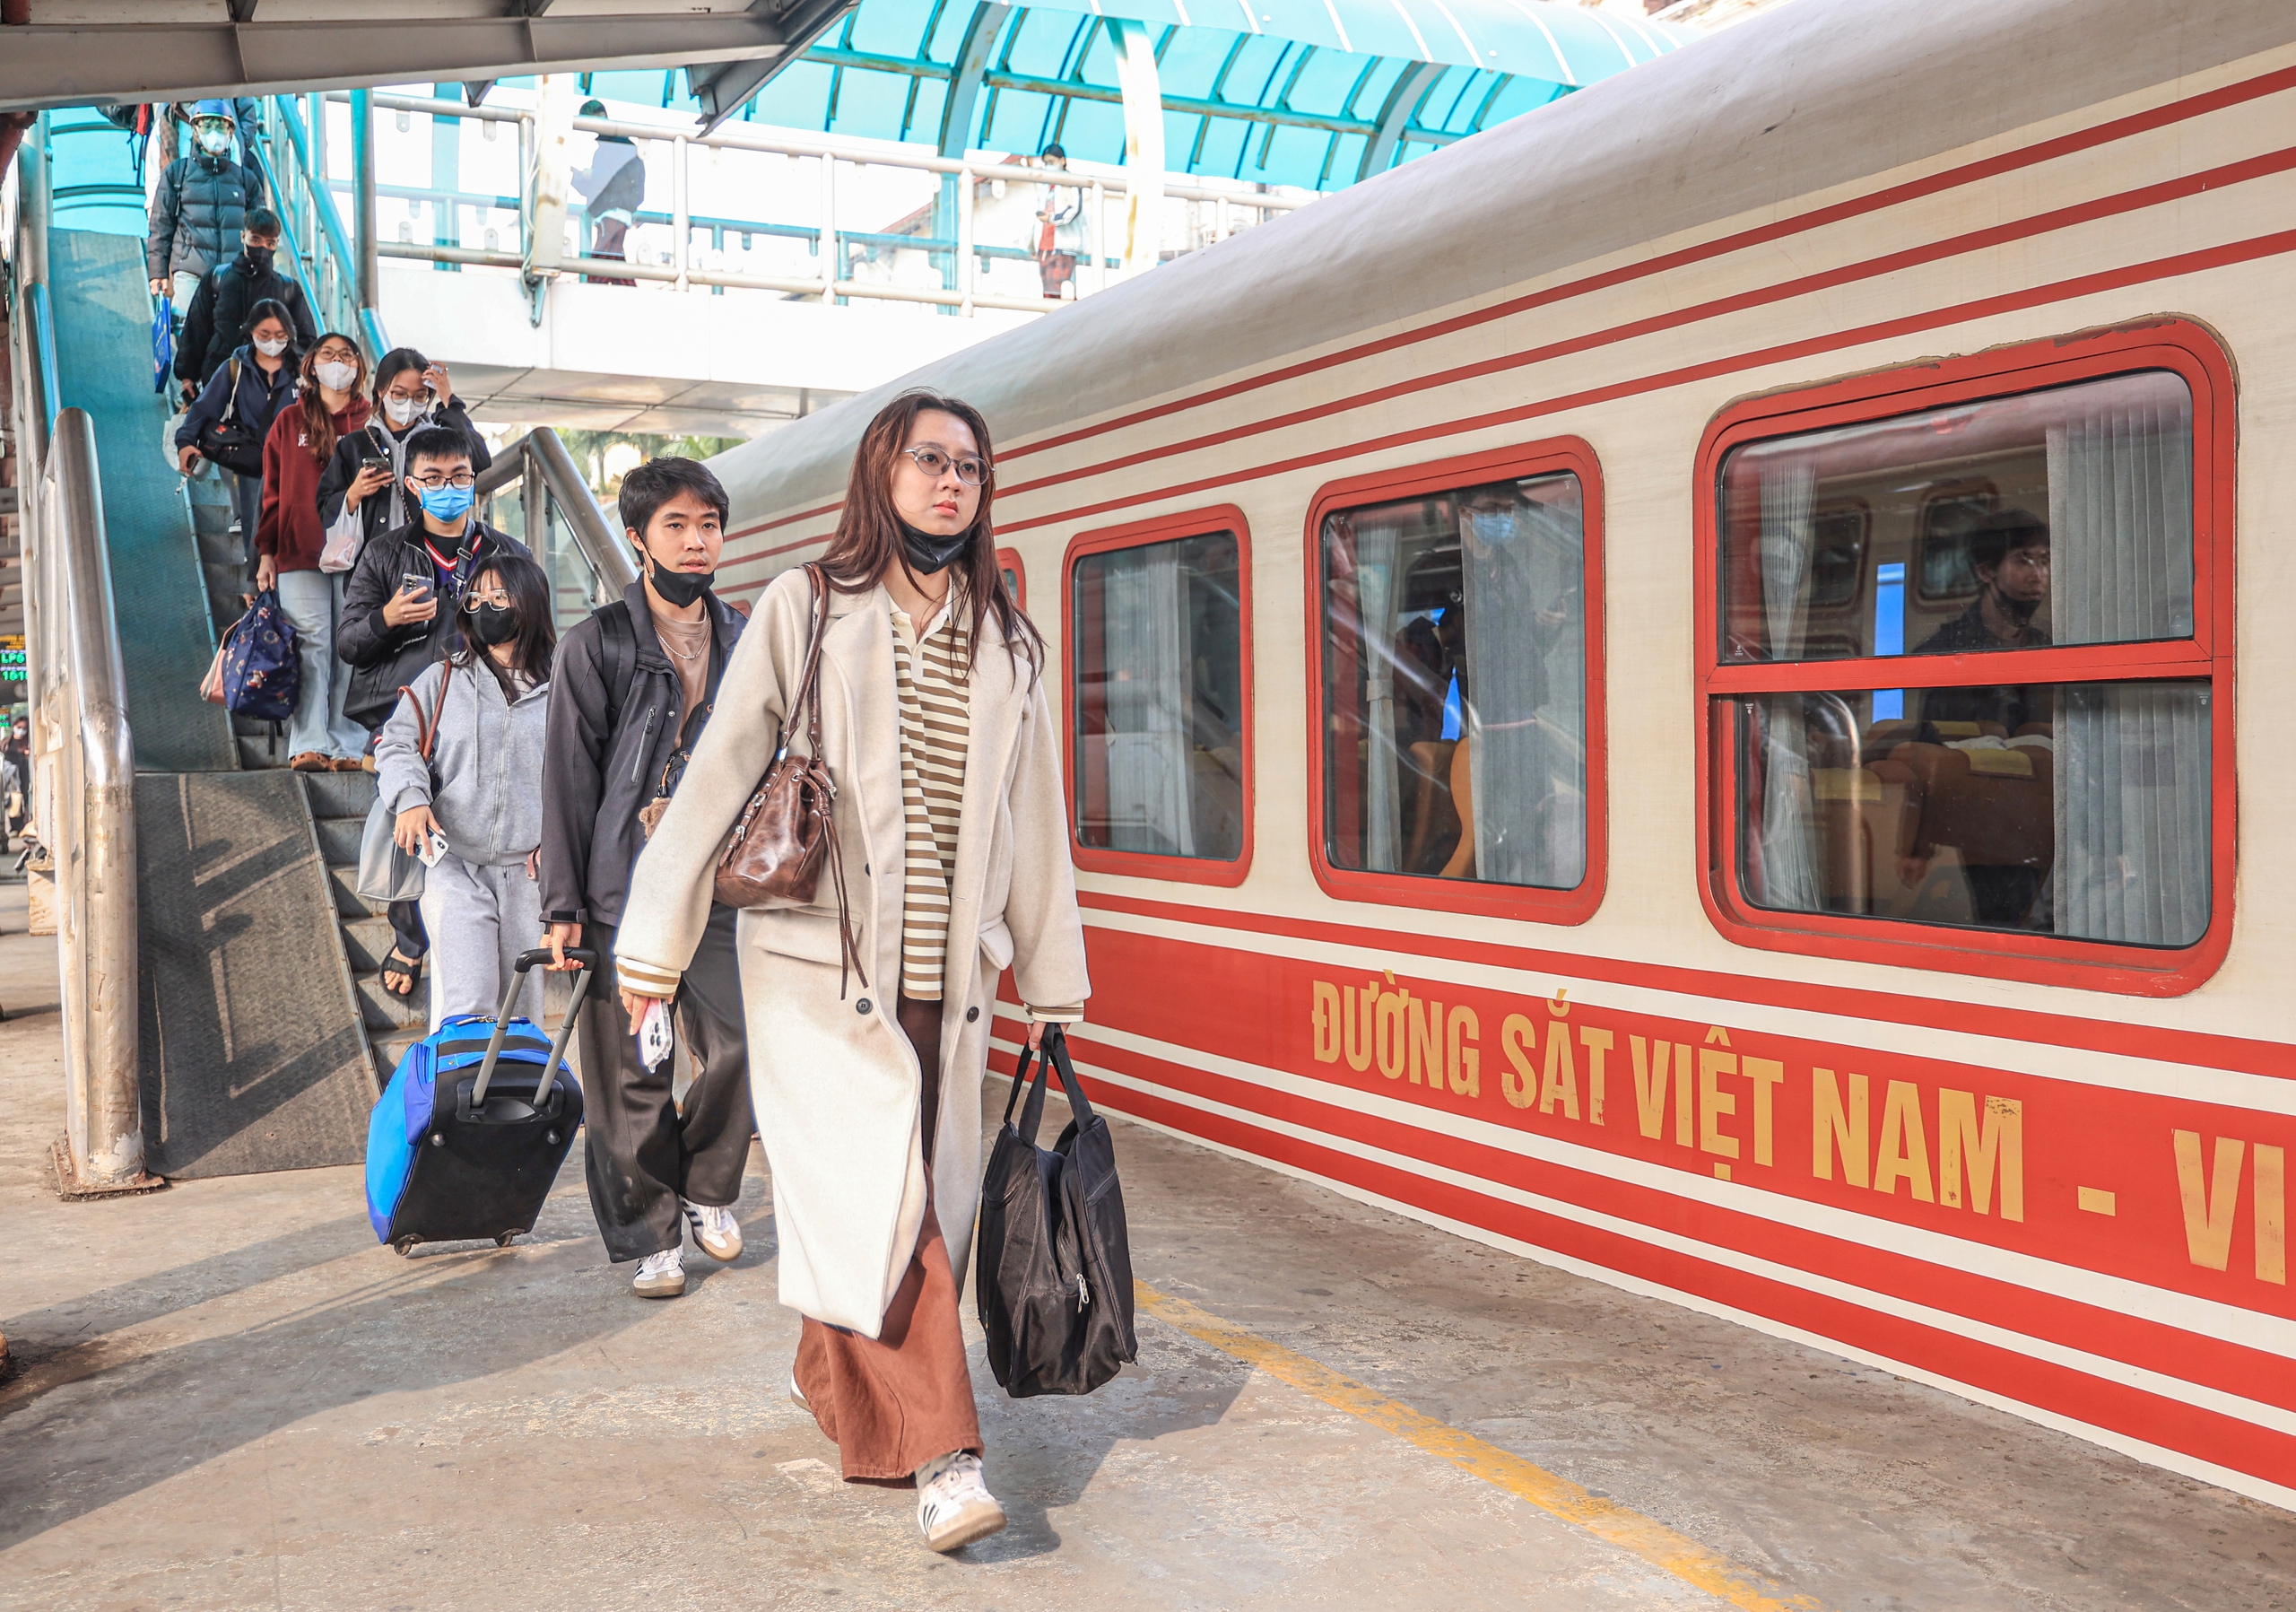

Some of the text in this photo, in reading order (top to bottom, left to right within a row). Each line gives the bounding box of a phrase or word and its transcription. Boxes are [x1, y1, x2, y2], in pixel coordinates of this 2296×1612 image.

[1312, 969, 2286, 1285] ĐƯỜNG SẮT VIỆT NAM - VI
